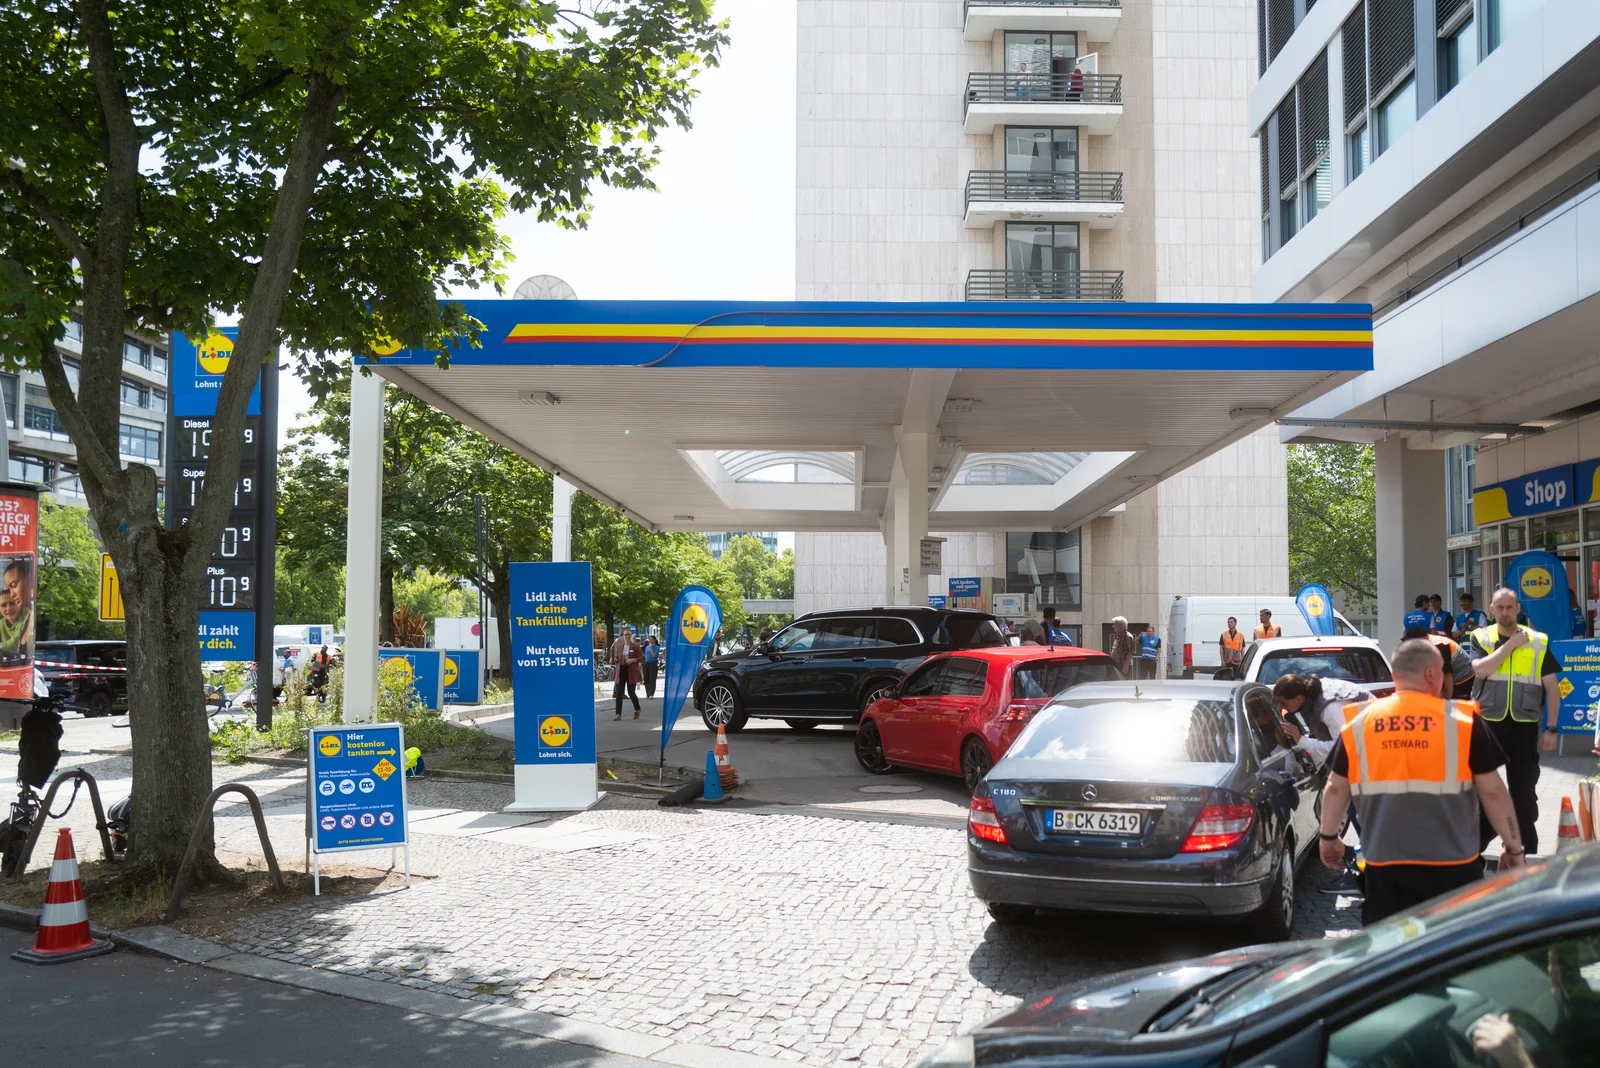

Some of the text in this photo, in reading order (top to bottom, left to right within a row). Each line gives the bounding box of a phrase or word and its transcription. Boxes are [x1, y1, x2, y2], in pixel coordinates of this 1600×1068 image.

[184, 420, 209, 428] Diesel
[1525, 480, 1566, 507] Shop
[0, 512, 30, 525] HECK
[207, 567, 225, 575] Plus
[525, 591, 577, 602] Lidl zahlt
[536, 604, 568, 614] deine
[516, 616, 588, 628] Tankfüllung!
[210, 625, 239, 636] zahlt
[207, 638, 237, 649] dich.
[526, 646, 580, 655] Nur heute
[517, 656, 589, 666] von 13-15 Uhr
[347, 740, 385, 748] kostenlos
[1381, 740, 1429, 750] STEWARD
[1055, 812, 1138, 831] B CK 6319
